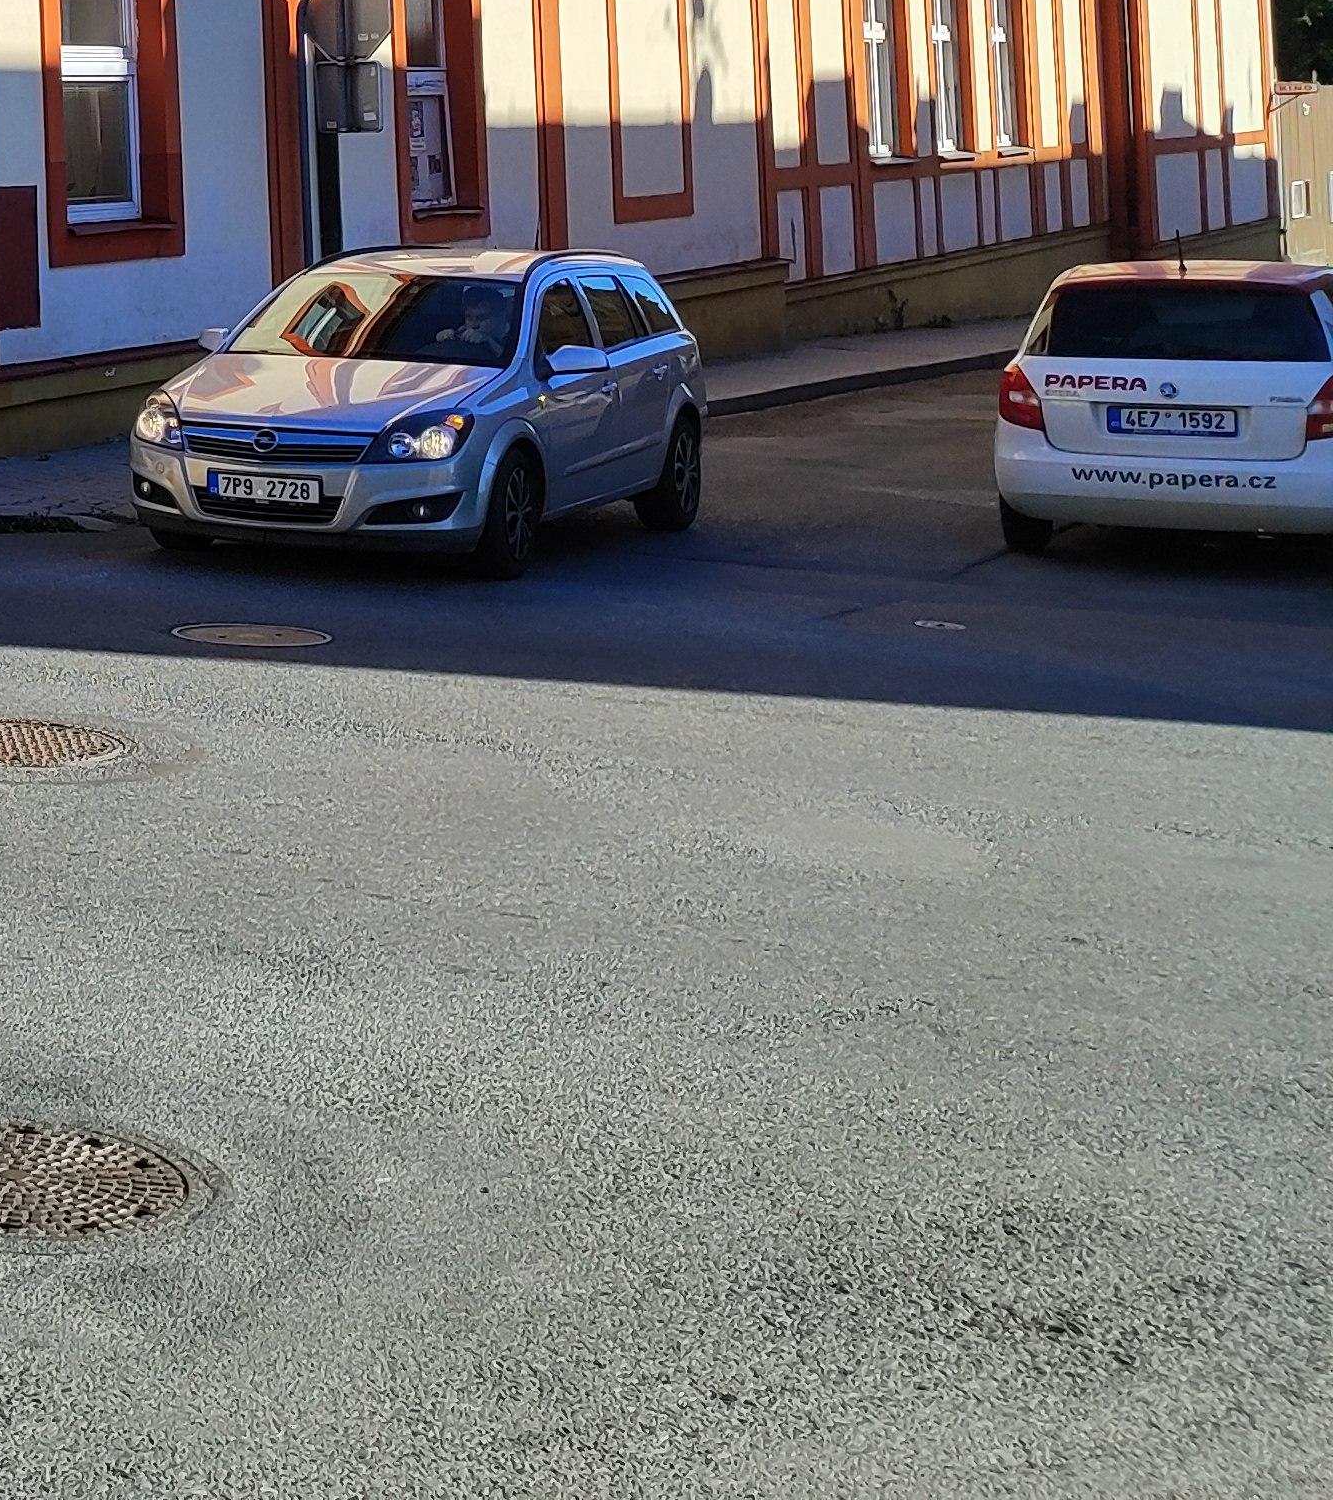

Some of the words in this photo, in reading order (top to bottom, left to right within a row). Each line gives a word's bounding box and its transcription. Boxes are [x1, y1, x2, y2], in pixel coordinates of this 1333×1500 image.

[1044, 374, 1148, 392] PAPERA
[1125, 410, 1161, 428] 4E7
[1178, 411, 1227, 430] 1592
[221, 476, 253, 496] 7P9
[266, 480, 310, 500] 2728
[1071, 467, 1278, 490] www.papera.cz
